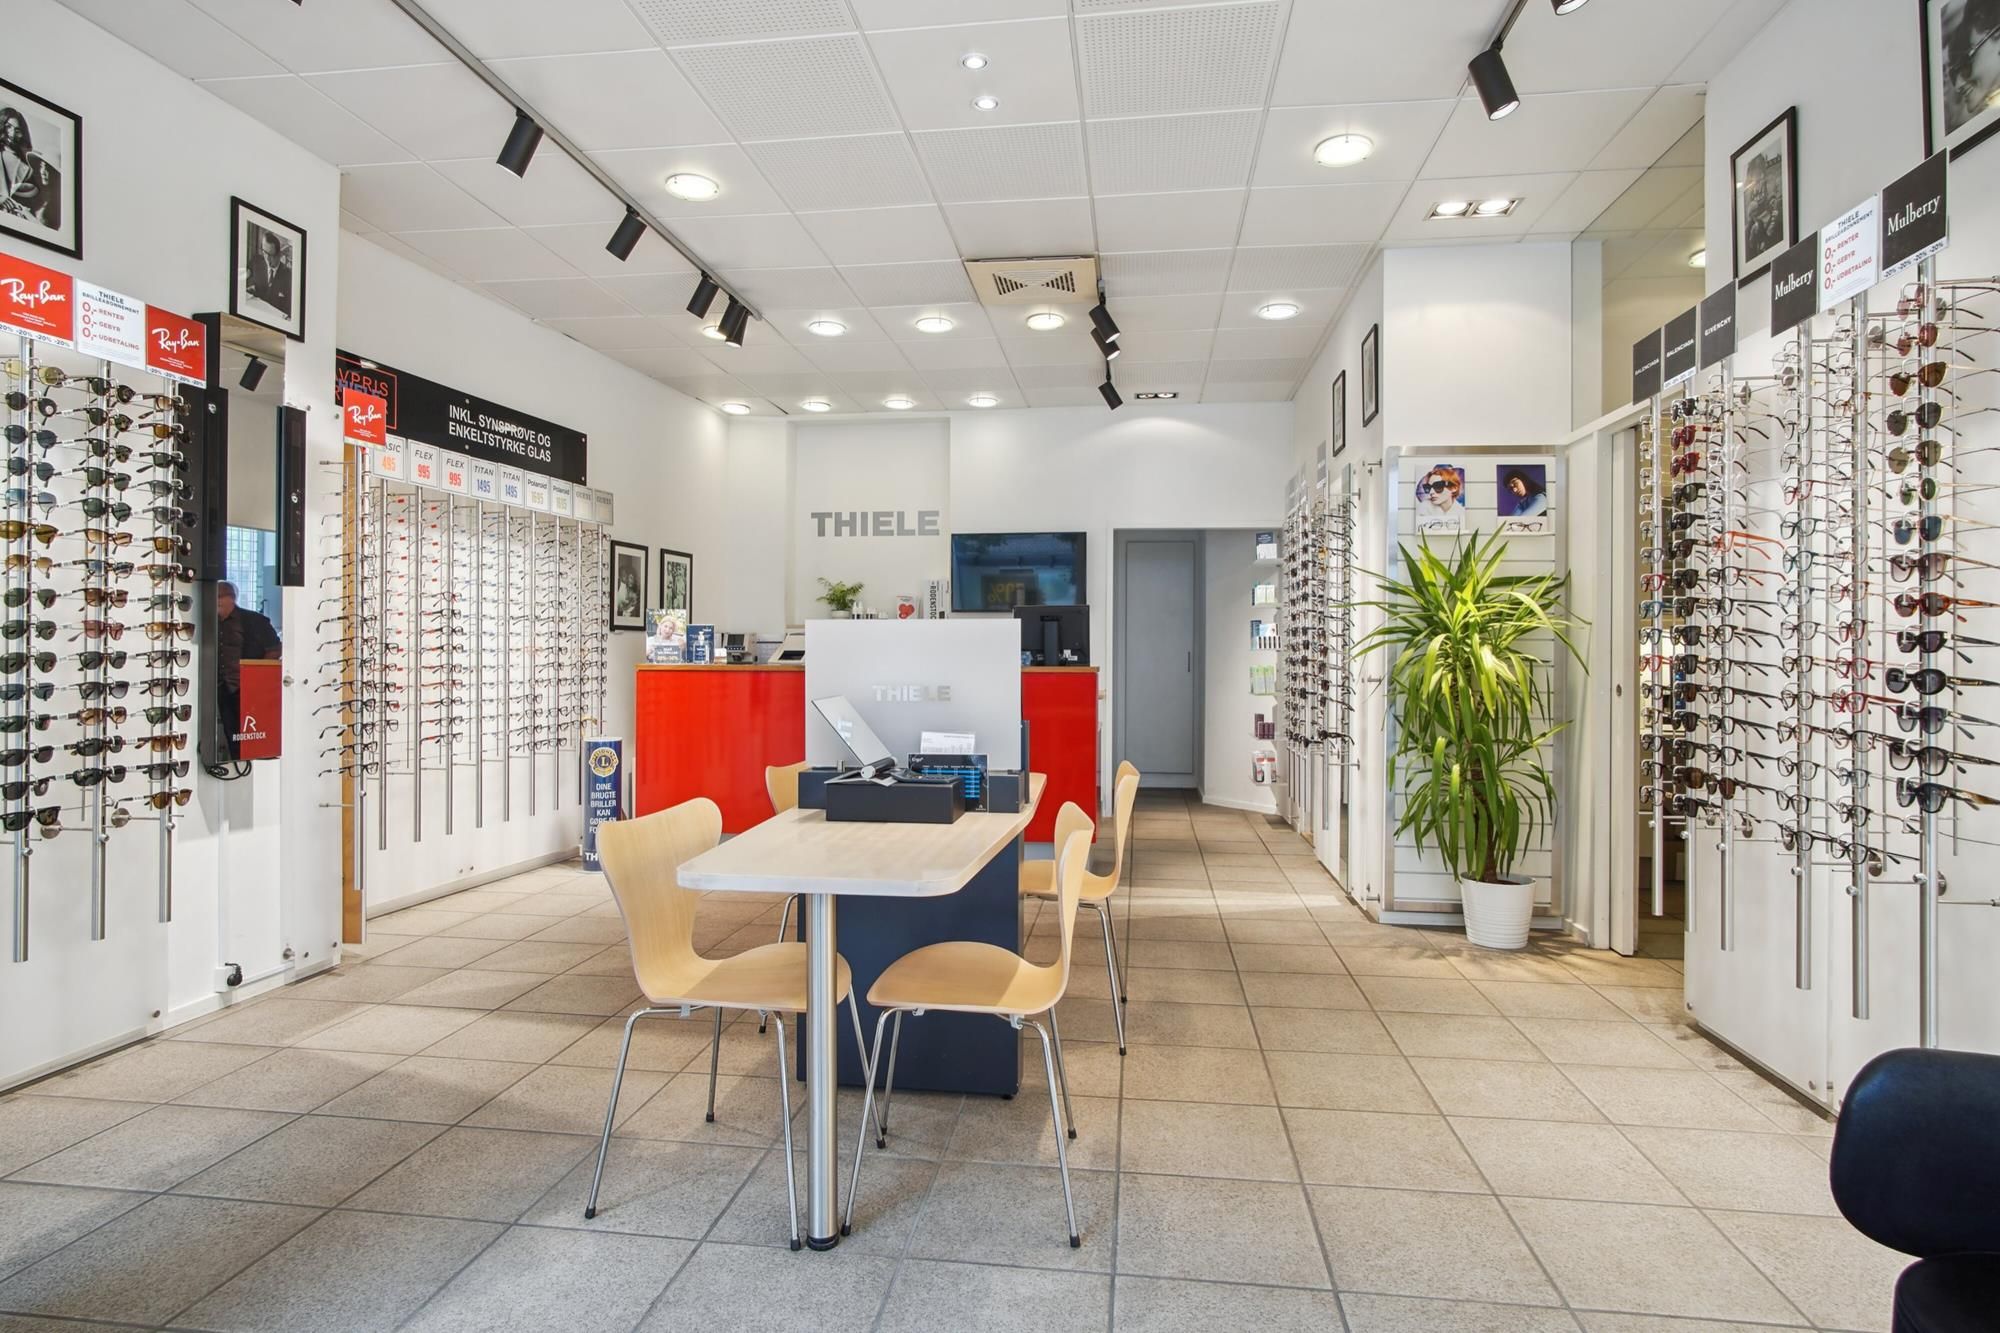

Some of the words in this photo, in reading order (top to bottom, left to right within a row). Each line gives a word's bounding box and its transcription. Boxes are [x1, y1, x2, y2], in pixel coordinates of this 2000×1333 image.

[1838, 211, 1859, 229] THIELE
[1887, 195, 1941, 236] Mulberry
[1837, 232, 1859, 249] RENTER
[1775, 269, 1814, 300] Mulberry
[0, 278, 66, 309] Ray-Ban
[98, 291, 124, 304] THIELE
[98, 308, 125, 321] RENTER
[0, 323, 13, 333] 20%
[1704, 316, 1732, 336] GIVENCHY
[152, 327, 200, 354] Ray-Ban
[335, 367, 388, 397] VPRIS
[450, 404, 475, 425] INKL.
[479, 414, 536, 443] SYNSPRØVE
[537, 433, 551, 448] OG
[385, 442, 402, 452] SIC
[449, 422, 526, 456] ENKELTSTYRKE
[527, 445, 552, 462] GLAS
[414, 449, 433, 461] FLEX
[445, 458, 465, 469] FLEX
[474, 465, 494, 476] TITAN
[417, 464, 431, 480] 995
[448, 471, 462, 487] 995
[502, 471, 521, 482] TITAN
[477, 479, 491, 494] 1495
[505, 484, 518, 499] 1495
[810, 510, 940, 537] THIELE
[929, 585, 937, 620] RODENSTOC
[872, 685, 951, 702] THIELE
[232, 731, 266, 741] RODENSTOCK
[596, 783, 612, 791] DINE
[591, 791, 616, 799] BRUGTE
[590, 799, 616, 808] BRILLER
[597, 808, 611, 817] KAN
